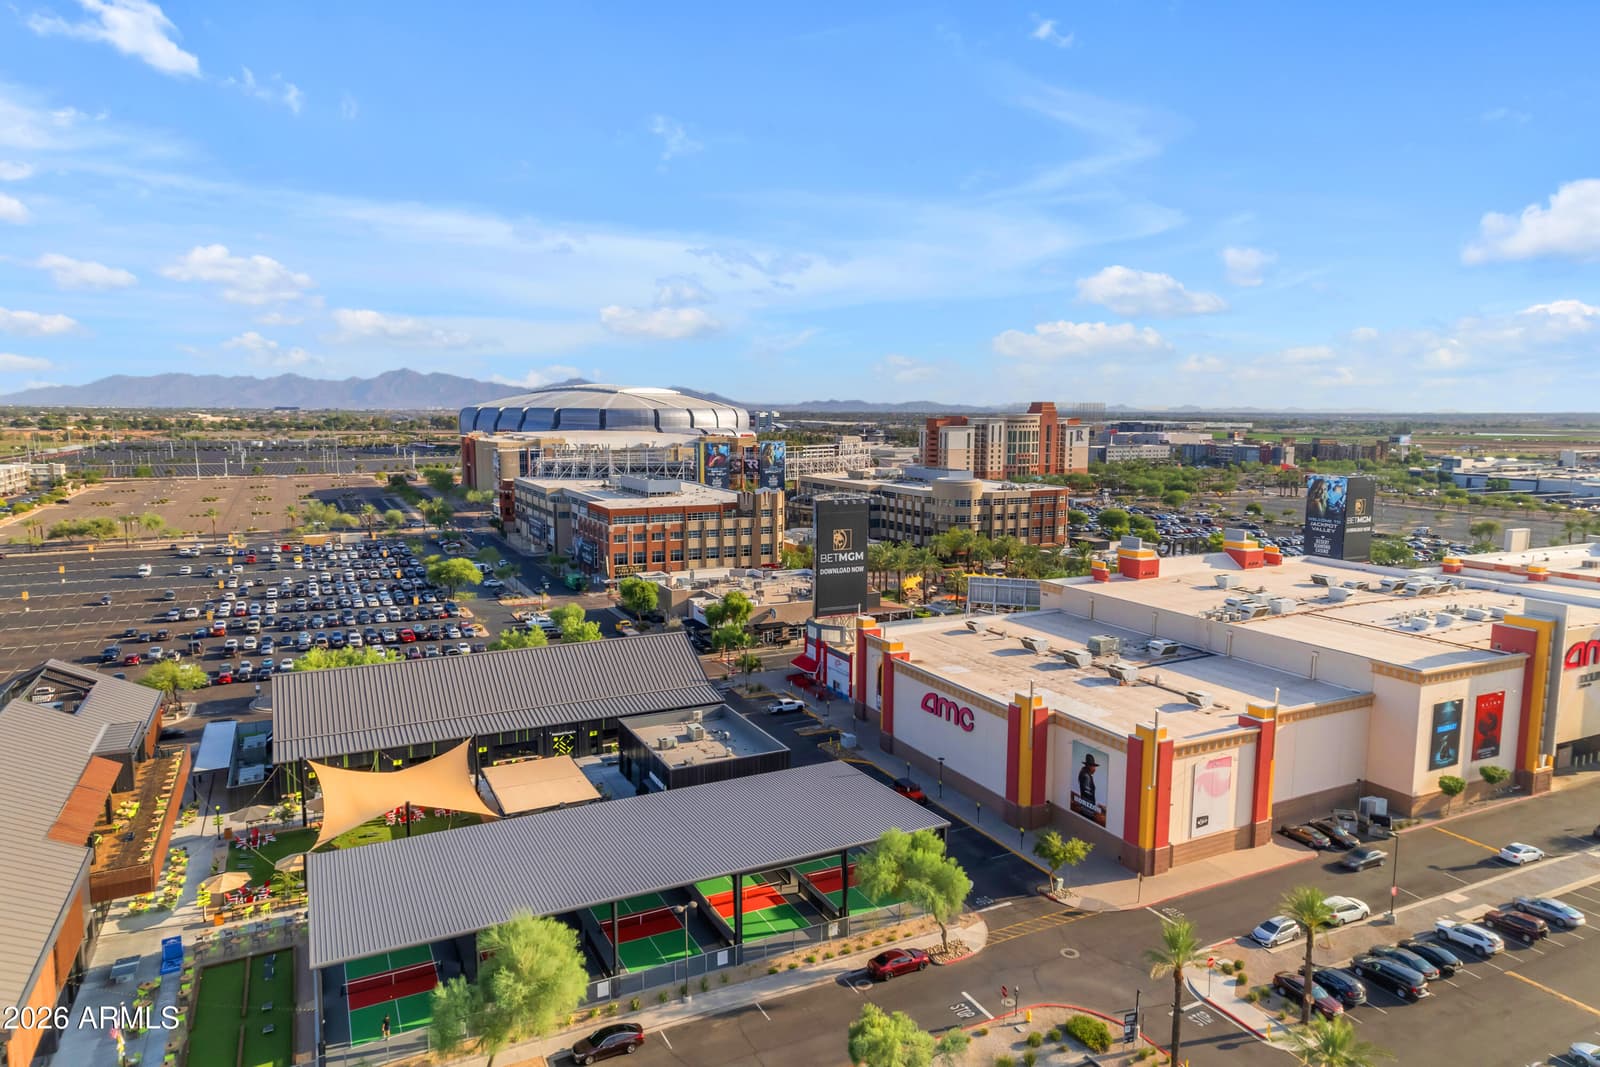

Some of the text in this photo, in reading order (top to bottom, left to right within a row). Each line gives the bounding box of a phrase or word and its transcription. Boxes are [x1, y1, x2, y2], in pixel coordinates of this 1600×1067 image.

[820, 551, 864, 563] BETMGM
[820, 567, 850, 575] DOWNLOAD
[949, 1002, 976, 1018] STOP
